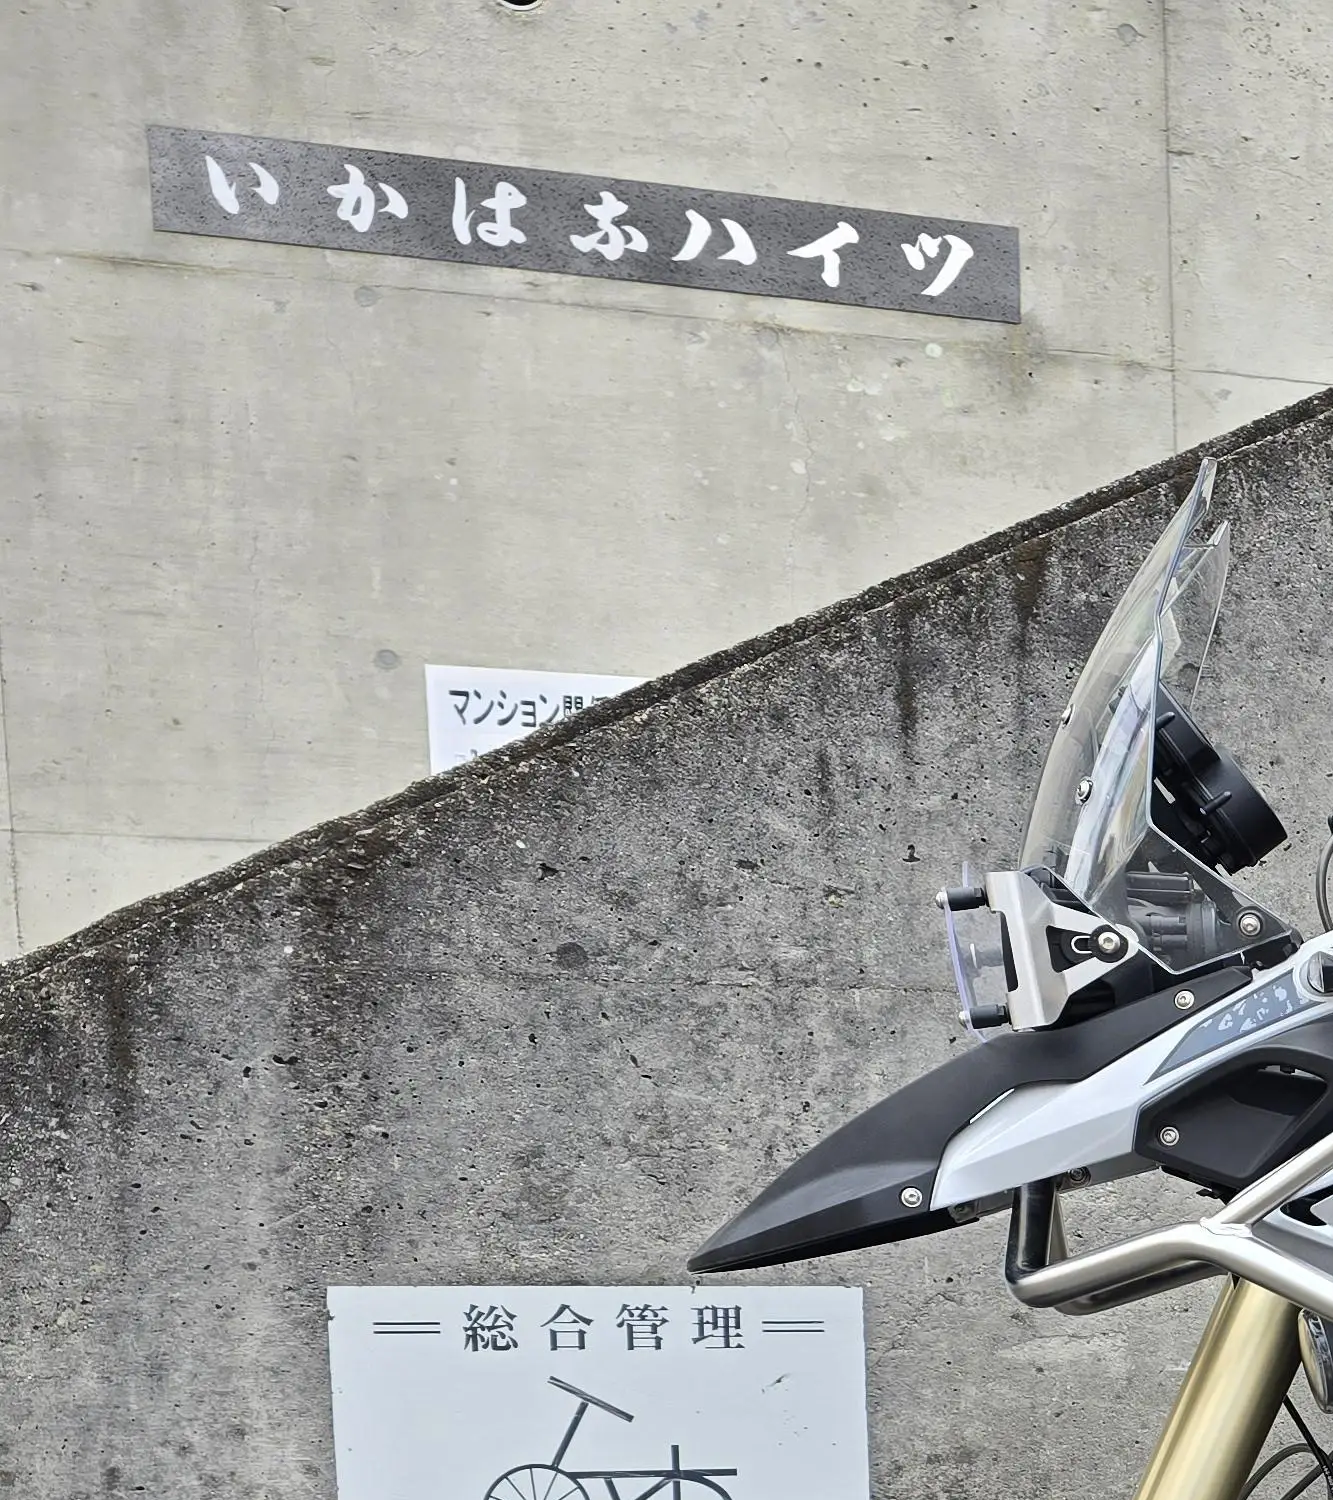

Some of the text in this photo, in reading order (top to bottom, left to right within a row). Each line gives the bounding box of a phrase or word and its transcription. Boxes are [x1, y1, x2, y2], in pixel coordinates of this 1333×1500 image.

[448, 689, 612, 728] マンション
[461, 1302, 747, 1352] 総合管理
